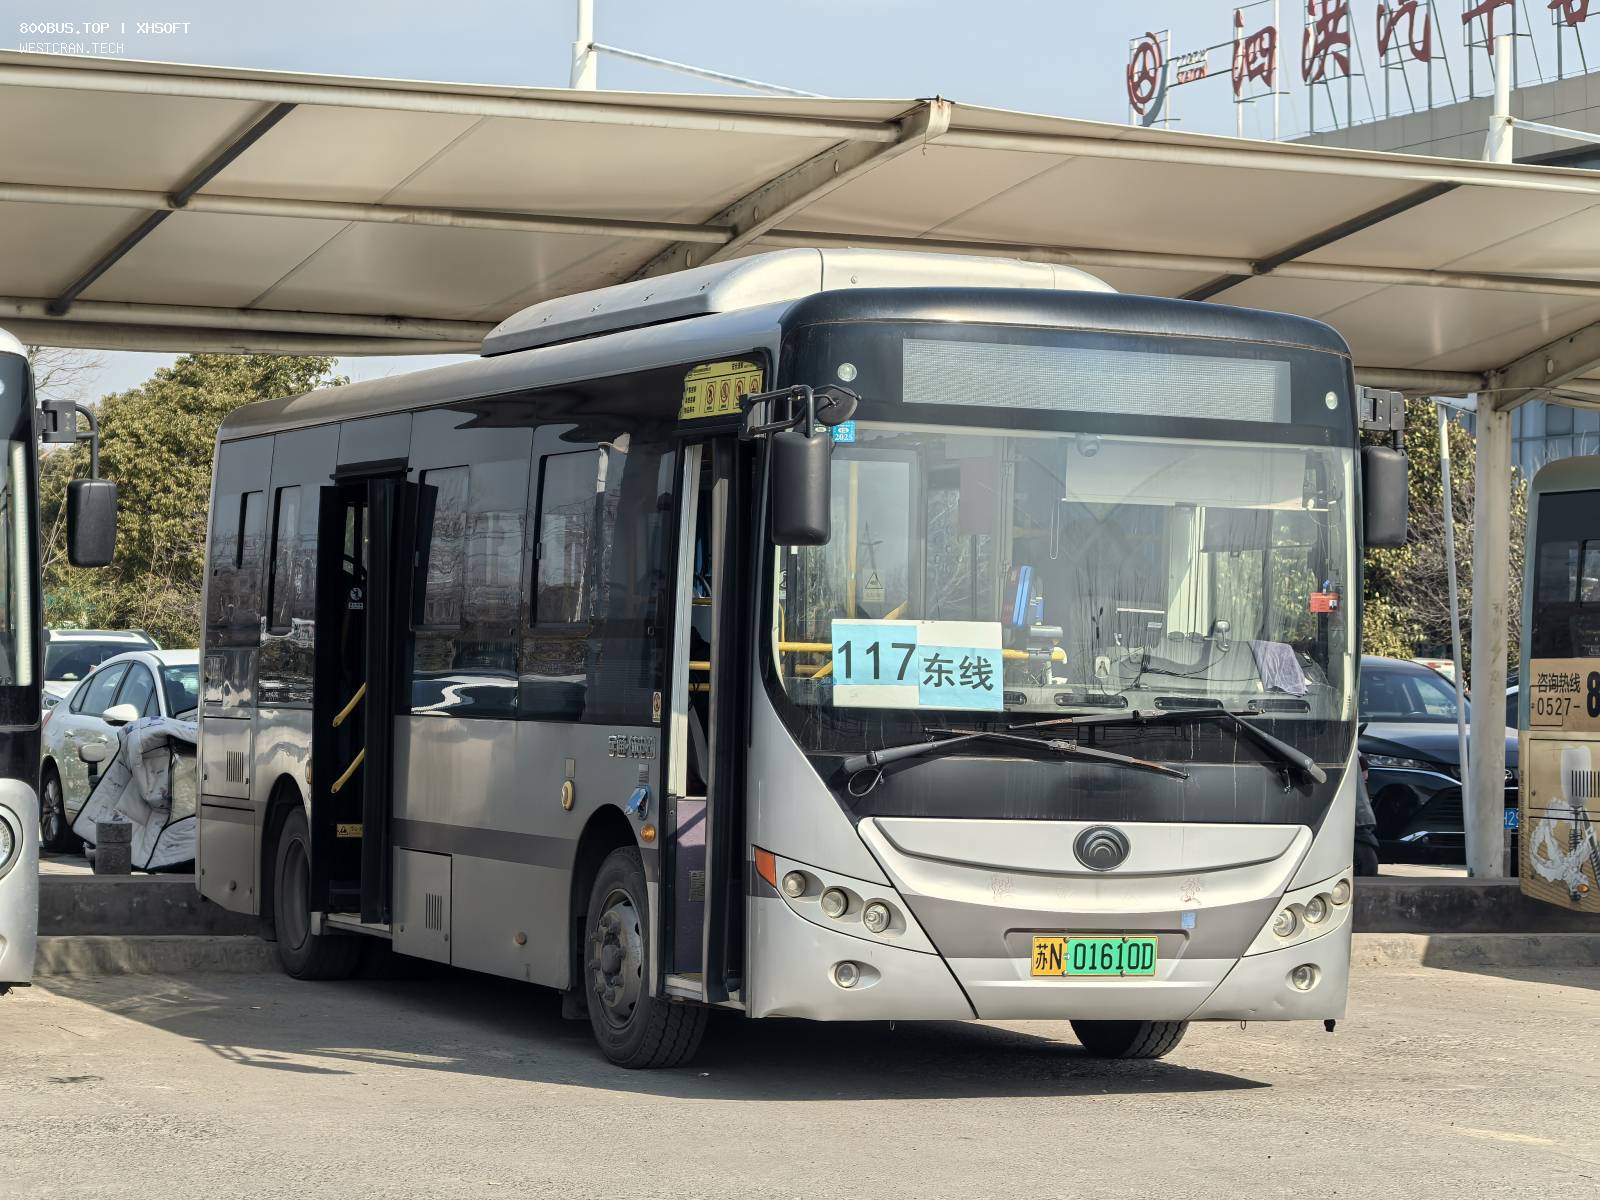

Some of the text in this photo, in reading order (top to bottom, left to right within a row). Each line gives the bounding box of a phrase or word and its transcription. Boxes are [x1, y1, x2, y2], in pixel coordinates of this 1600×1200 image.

[1233, 0, 1589, 96] 泗洪汽
[838, 640, 994, 692] 117 东线
[1537, 672, 1581, 694] 咨询热线
[1537, 671, 1600, 718] 0527- 8
[1073, 943, 1154, 970] 01610D
